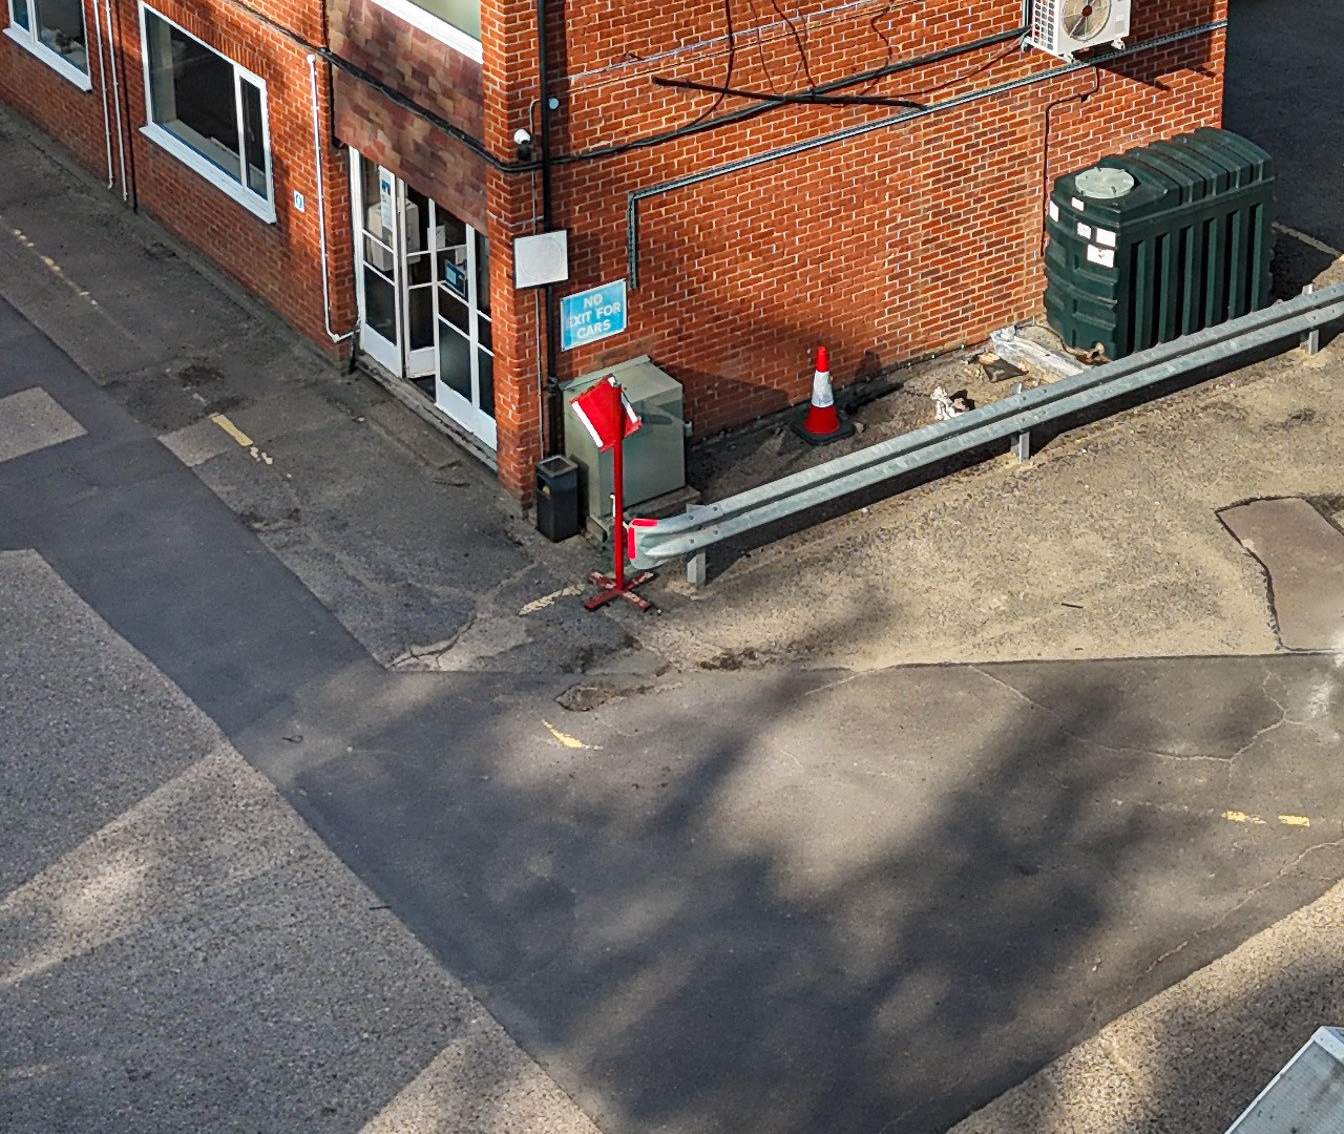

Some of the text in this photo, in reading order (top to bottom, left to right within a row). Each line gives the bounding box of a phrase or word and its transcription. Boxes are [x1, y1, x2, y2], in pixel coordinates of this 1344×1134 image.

[583, 293, 603, 309] NO
[570, 301, 621, 327] EXIT FOR
[577, 319, 611, 339] CARS
